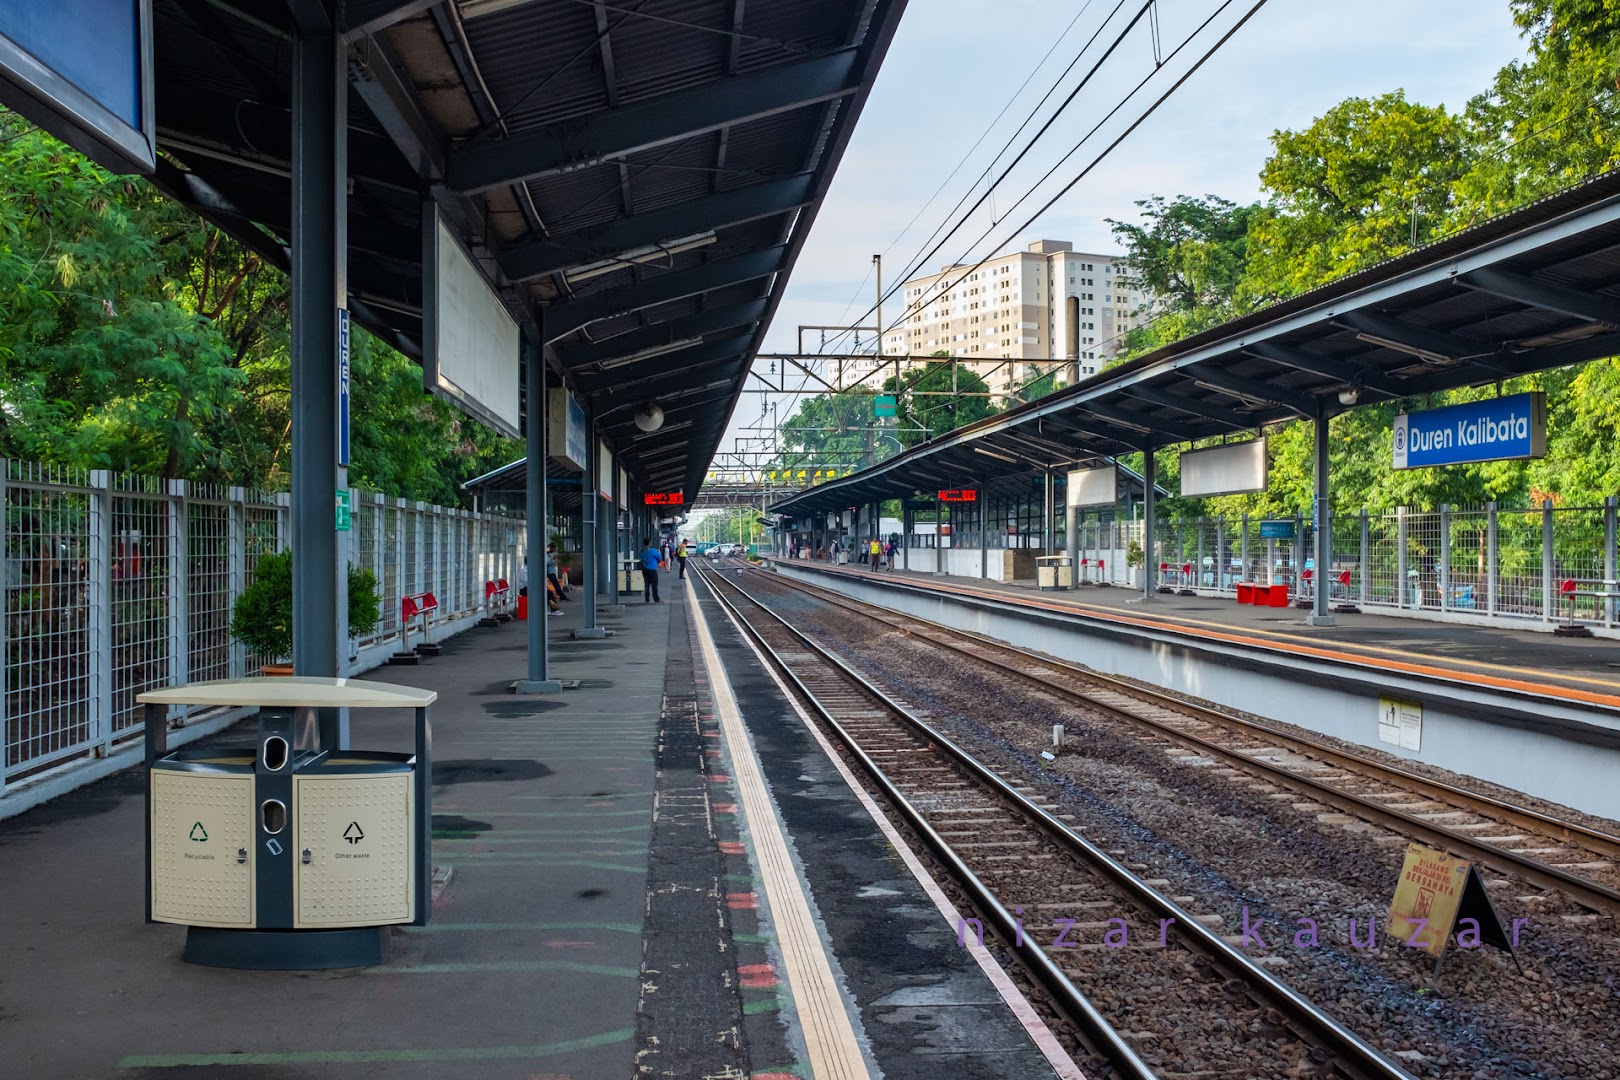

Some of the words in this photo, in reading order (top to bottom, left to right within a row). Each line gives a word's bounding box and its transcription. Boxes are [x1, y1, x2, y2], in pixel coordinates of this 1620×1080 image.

[1410, 427, 1453, 452] Duren
[1457, 413, 1528, 447] Kalibata
[184, 853, 215, 861] Recyclable
[335, 852, 352, 860] Other
[1412, 864, 1436, 879] BERJALAN
[1419, 859, 1449, 874] DILARANG
[1406, 871, 1454, 897] BERBAHAYA
